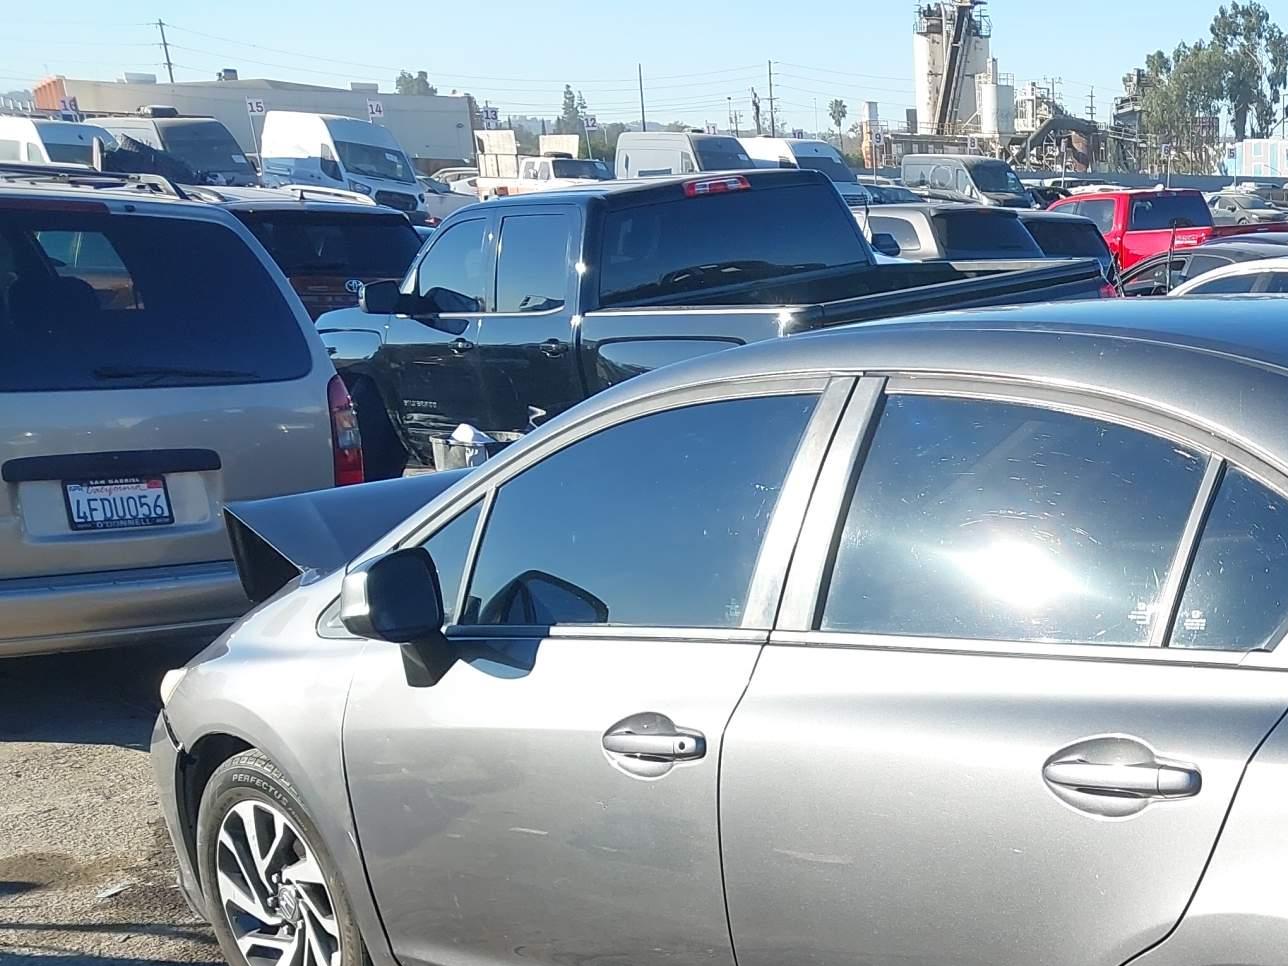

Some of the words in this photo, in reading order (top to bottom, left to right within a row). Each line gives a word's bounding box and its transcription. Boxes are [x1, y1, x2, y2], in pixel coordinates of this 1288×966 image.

[248, 101, 264, 113] 15
[369, 104, 382, 115] 14
[485, 110, 498, 120] 13
[585, 118, 596, 127] 12
[875, 133, 882, 143] 9
[76, 494, 165, 522] 4FDU056
[232, 773, 289, 807] PERFECTUS
